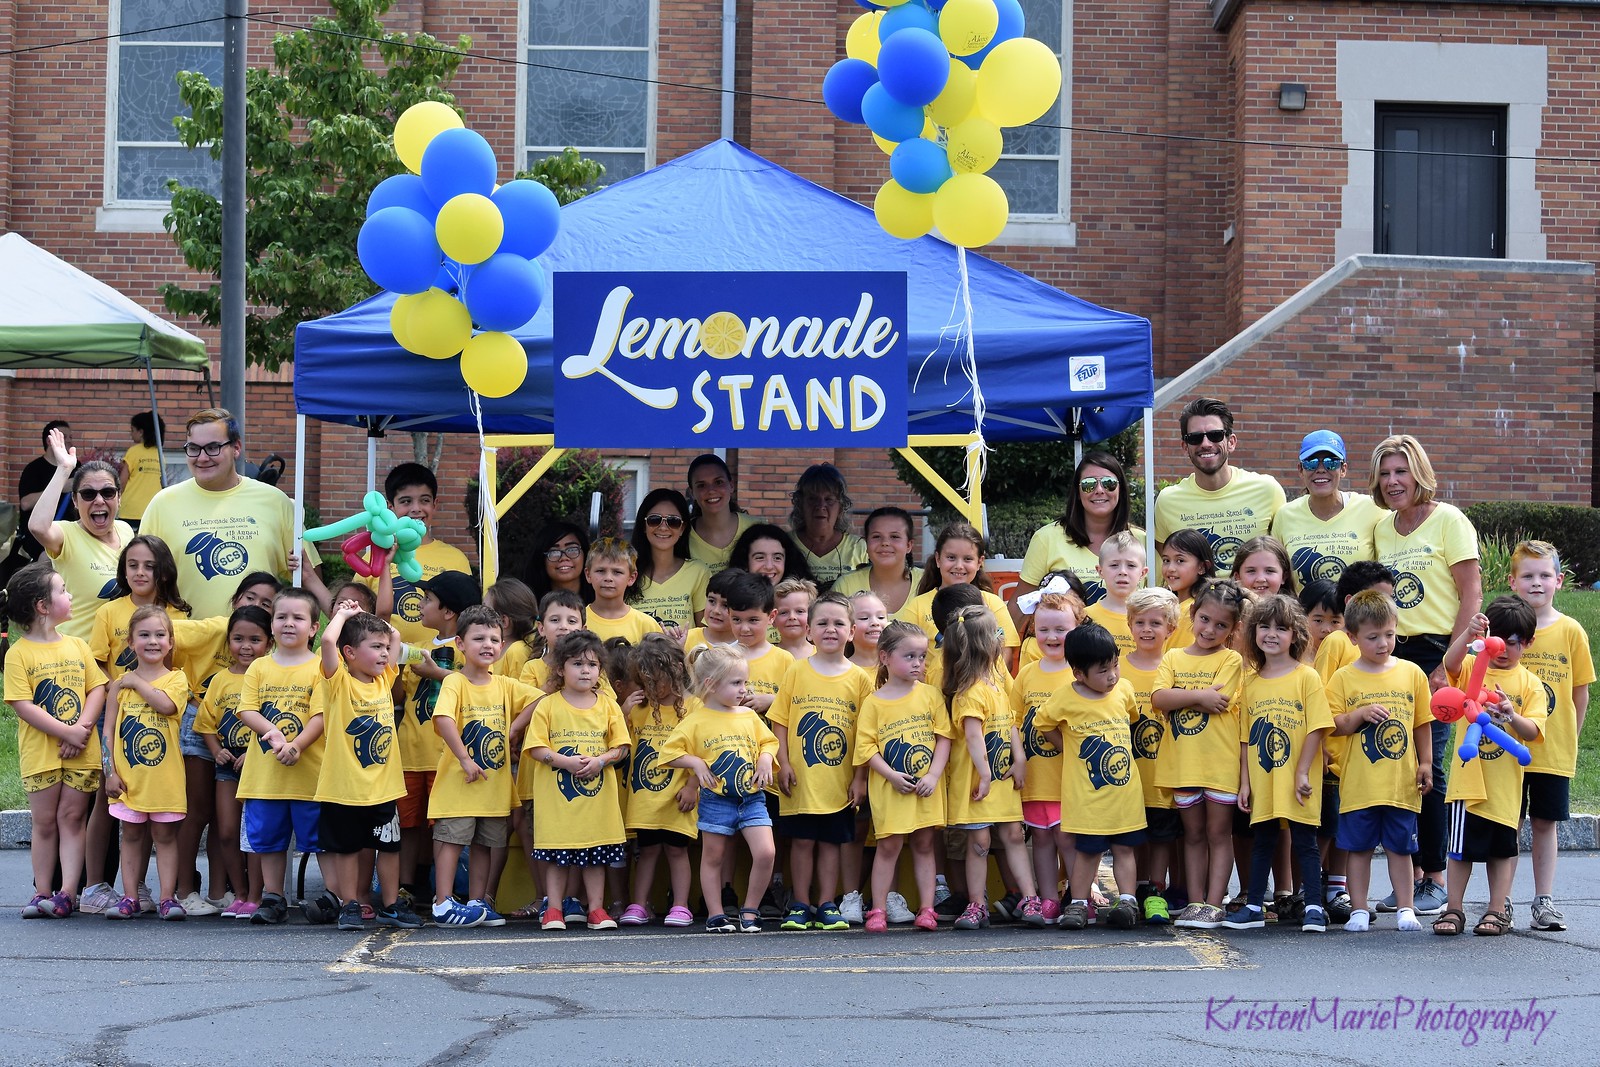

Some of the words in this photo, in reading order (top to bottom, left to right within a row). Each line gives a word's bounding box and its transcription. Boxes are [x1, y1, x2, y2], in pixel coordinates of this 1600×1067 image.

[561, 286, 899, 410] Lemonade
[692, 370, 887, 434] STAND
[1196, 512, 1224, 520] Lemonade
[1226, 509, 1242, 517] Stand
[220, 550, 241, 566] SCS
[225, 563, 246, 575] SAINTS
[1320, 565, 1341, 579] SCS
[1398, 581, 1417, 599] SCS
[1402, 594, 1423, 608] SAINTS
[1542, 652, 1557, 660] Stand
[1542, 675, 1561, 683] 8.10.18
[1547, 669, 1568, 679] Annual
[808, 694, 833, 703] Lemonade
[1361, 691, 1390, 699] Lemonade
[1391, 690, 1406, 699] Stand
[58, 698, 75, 716] SCS
[1279, 697, 1293, 707] Stand
[911, 713, 926, 722] Stand
[281, 723, 296, 736] CS
[563, 729, 588, 737] Lemonade
[1184, 721, 1206, 735] SAINTS
[823, 738, 841, 754] SCS
[1143, 731, 1160, 748] SCS
[1384, 731, 1403, 748] SCS
[140, 739, 160, 755] SCS
[145, 752, 164, 765] SAINTS
[912, 754, 929, 774] SCS
[1110, 757, 1127, 775] SCS
[650, 778, 670, 790] SAINTS
